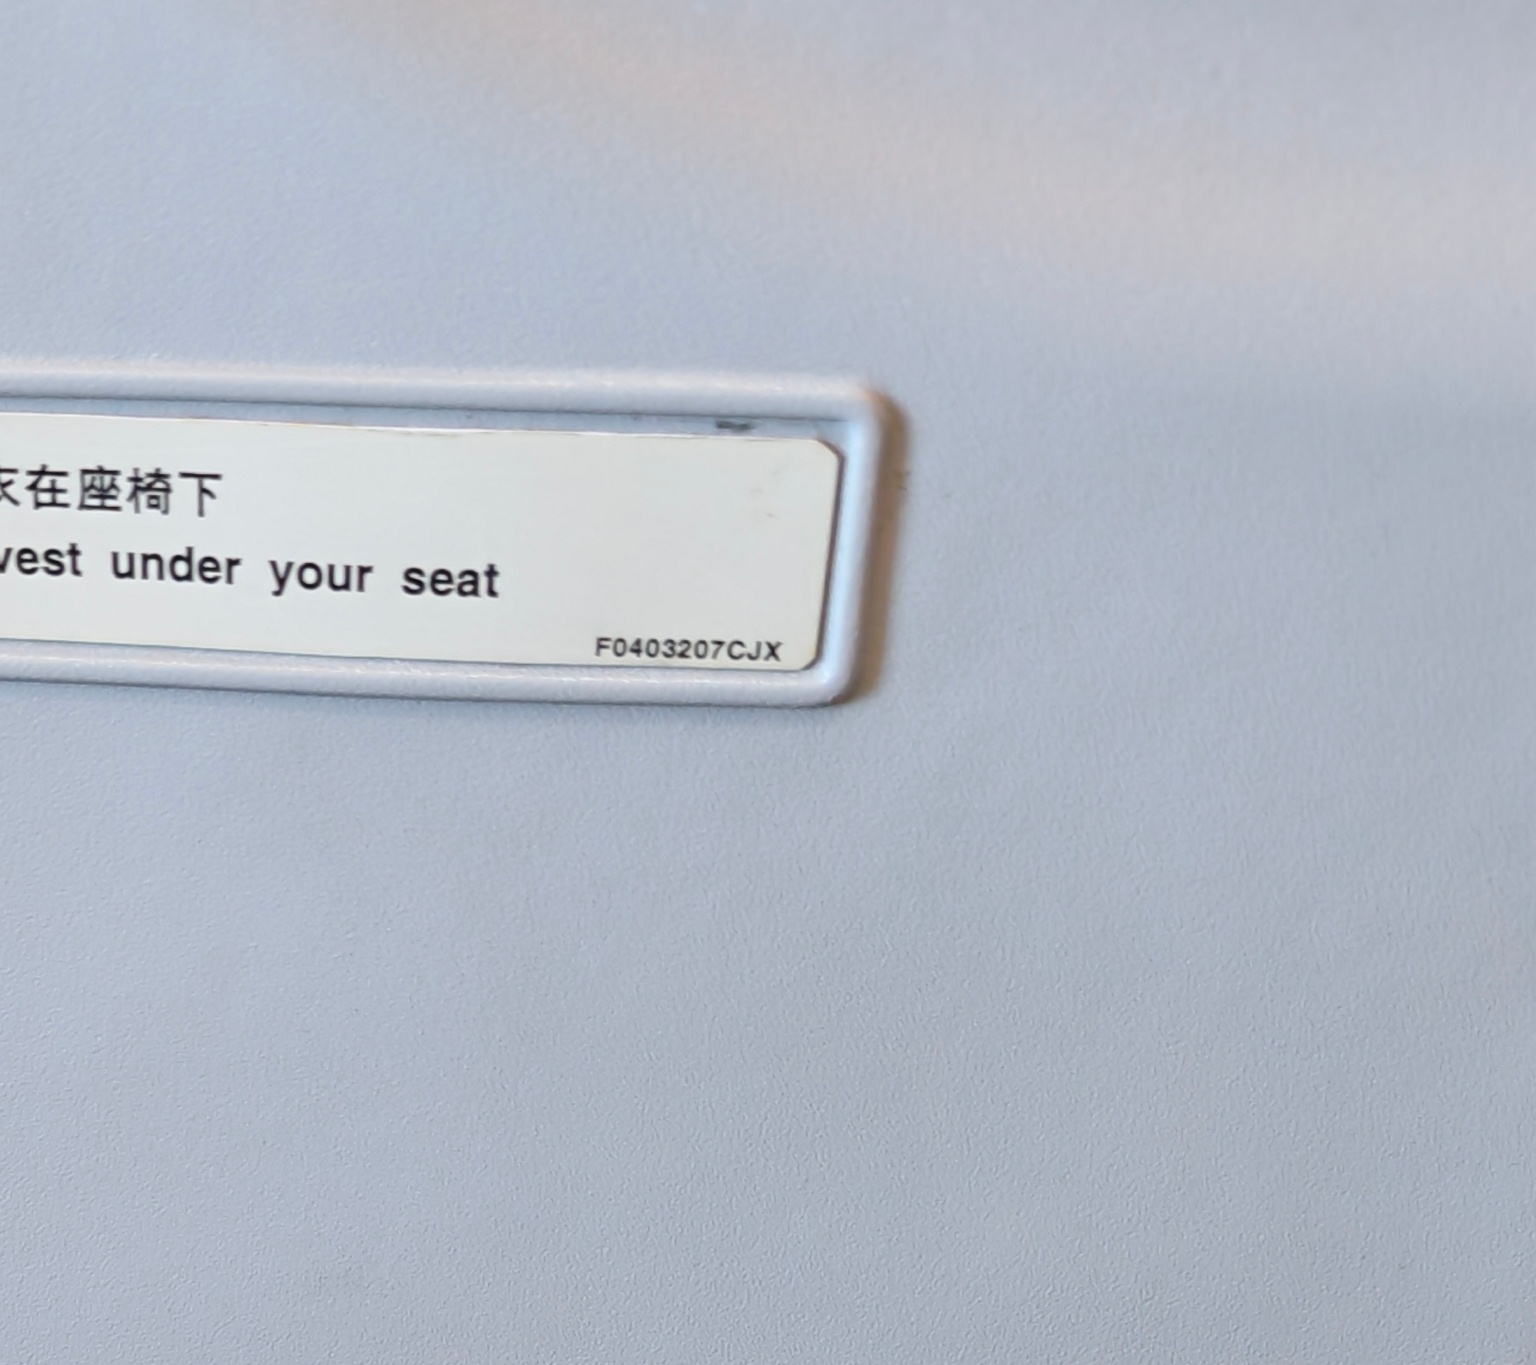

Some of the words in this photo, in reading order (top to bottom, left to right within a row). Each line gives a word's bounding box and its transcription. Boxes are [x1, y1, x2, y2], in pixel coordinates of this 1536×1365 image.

[111, 544, 242, 589] under
[270, 558, 374, 598] your
[401, 560, 500, 602] seat
[593, 636, 784, 663] F0403207CJX
